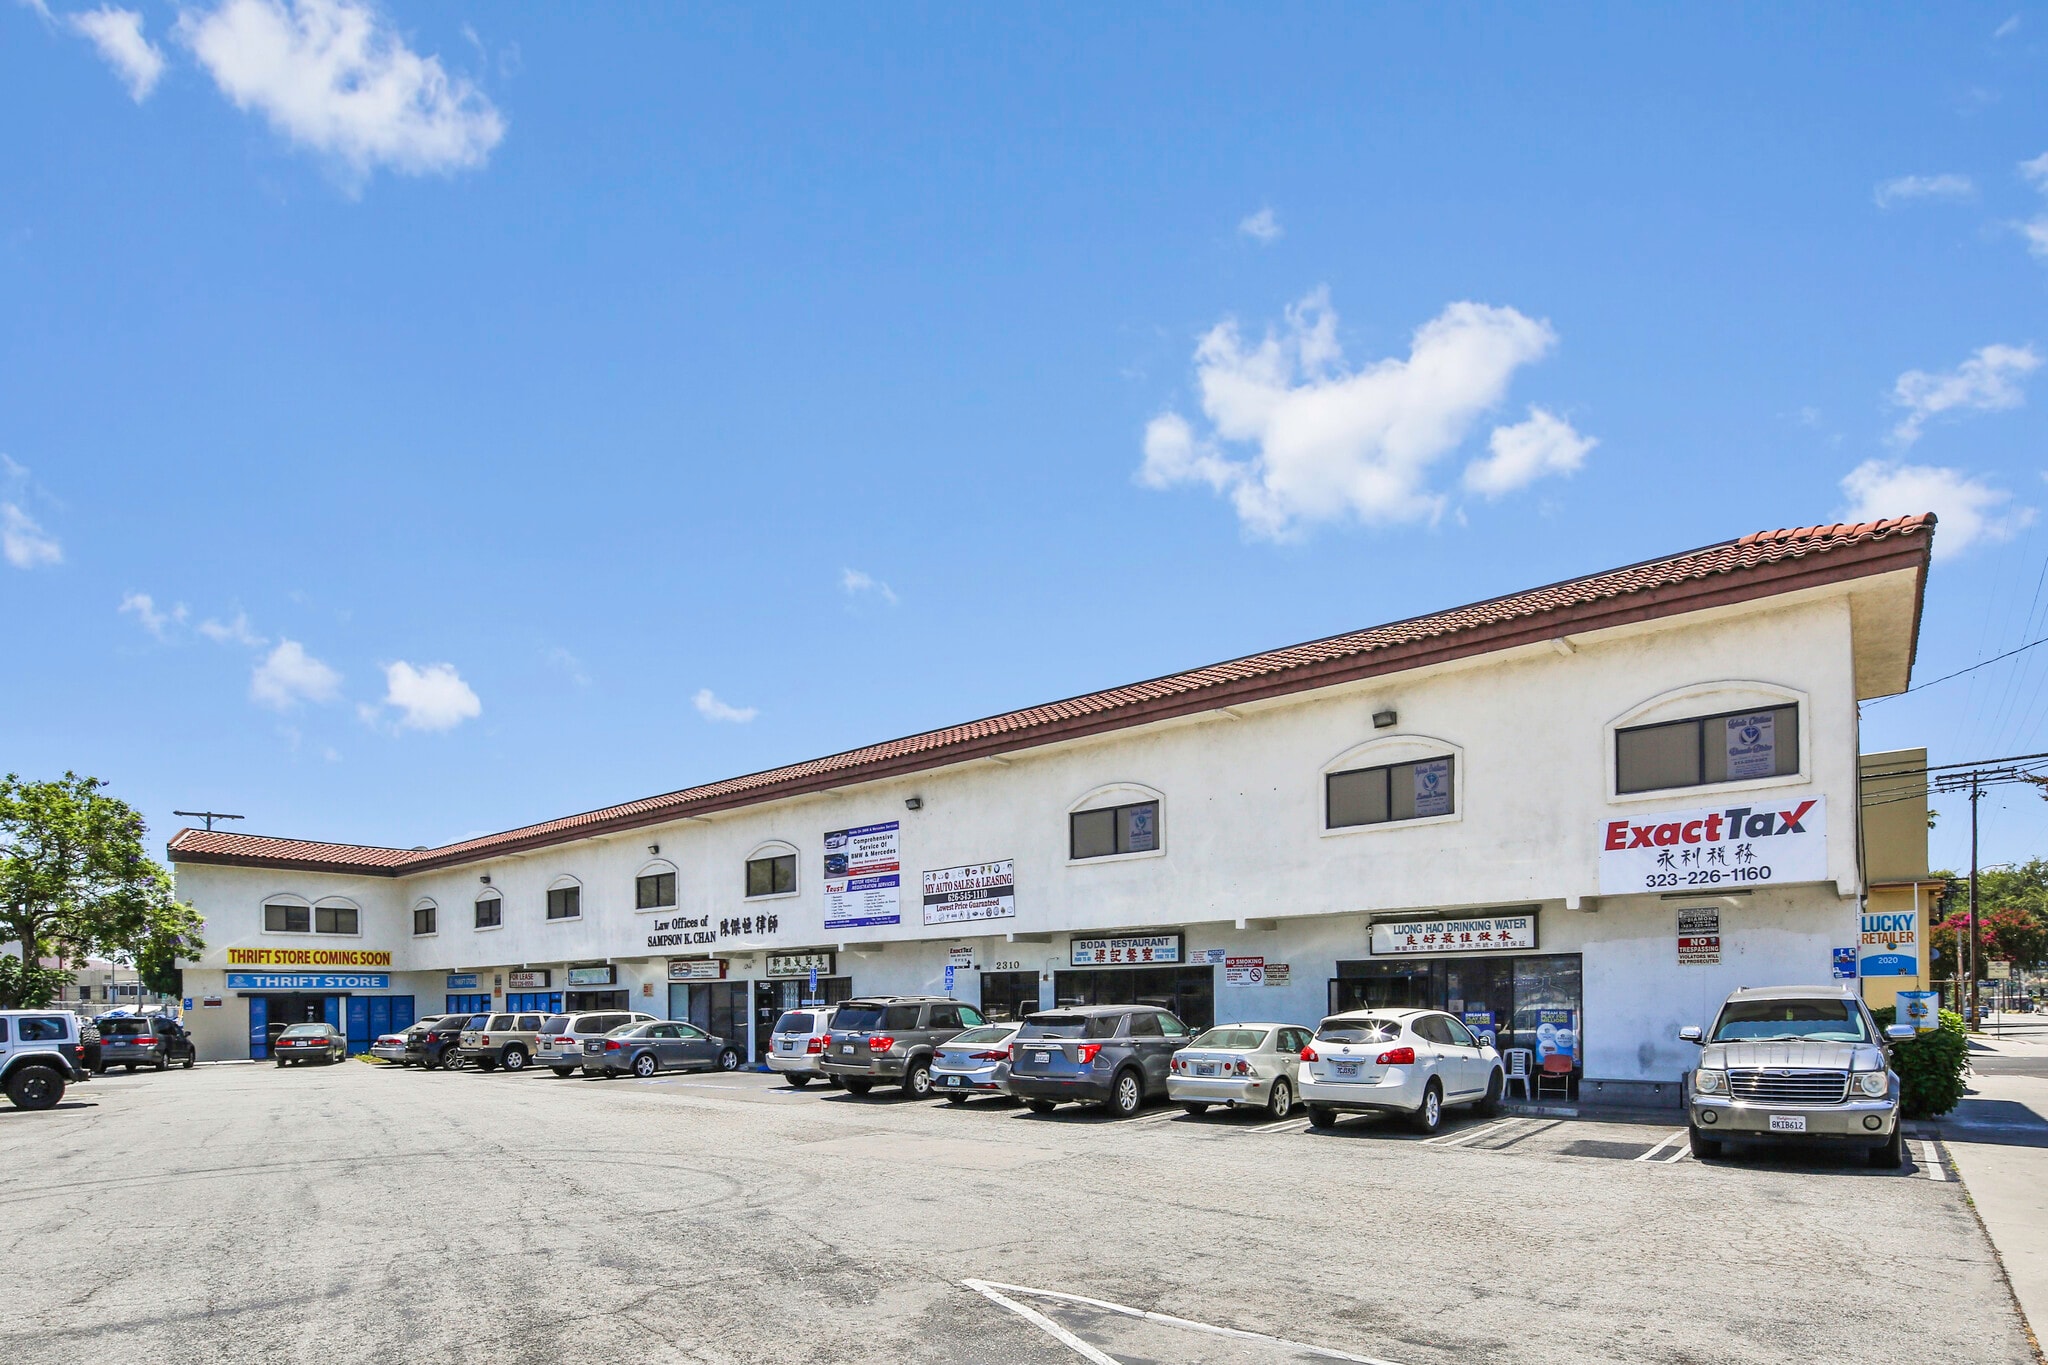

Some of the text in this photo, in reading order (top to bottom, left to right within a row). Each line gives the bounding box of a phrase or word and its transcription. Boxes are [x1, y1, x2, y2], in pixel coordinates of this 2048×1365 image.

[1604, 799, 1818, 851] ExactTax
[853, 834, 894, 844] Comprehensive
[859, 843, 879, 851] Service
[870, 848, 896, 857] Mercedes
[1646, 865, 1772, 888] 323-226-1160
[925, 874, 1012, 894] MY AUTO SALES & LEASING
[936, 898, 1000, 912] Lowest Price Guaranteed
[654, 915, 708, 931] Law Offices of
[1394, 918, 1526, 935] LUONG HAO DRINKING WATER
[1861, 914, 1914, 932] LUCKY
[648, 931, 716, 947] SAMPSON K. CHAN
[1080, 938, 1170, 949] BODA RESTAURANT
[1690, 938, 1707, 946] NO
[1862, 931, 1914, 944] RETAILER
[230, 949, 390, 965] THRIFT STORE COMING SOON
[1878, 956, 1898, 964] 2020
[996, 961, 1020, 970] 2310
[253, 976, 320, 987] THRIFT
[324, 976, 380, 987] STORE
[1772, 1120, 1804, 1129] 8KIB612
